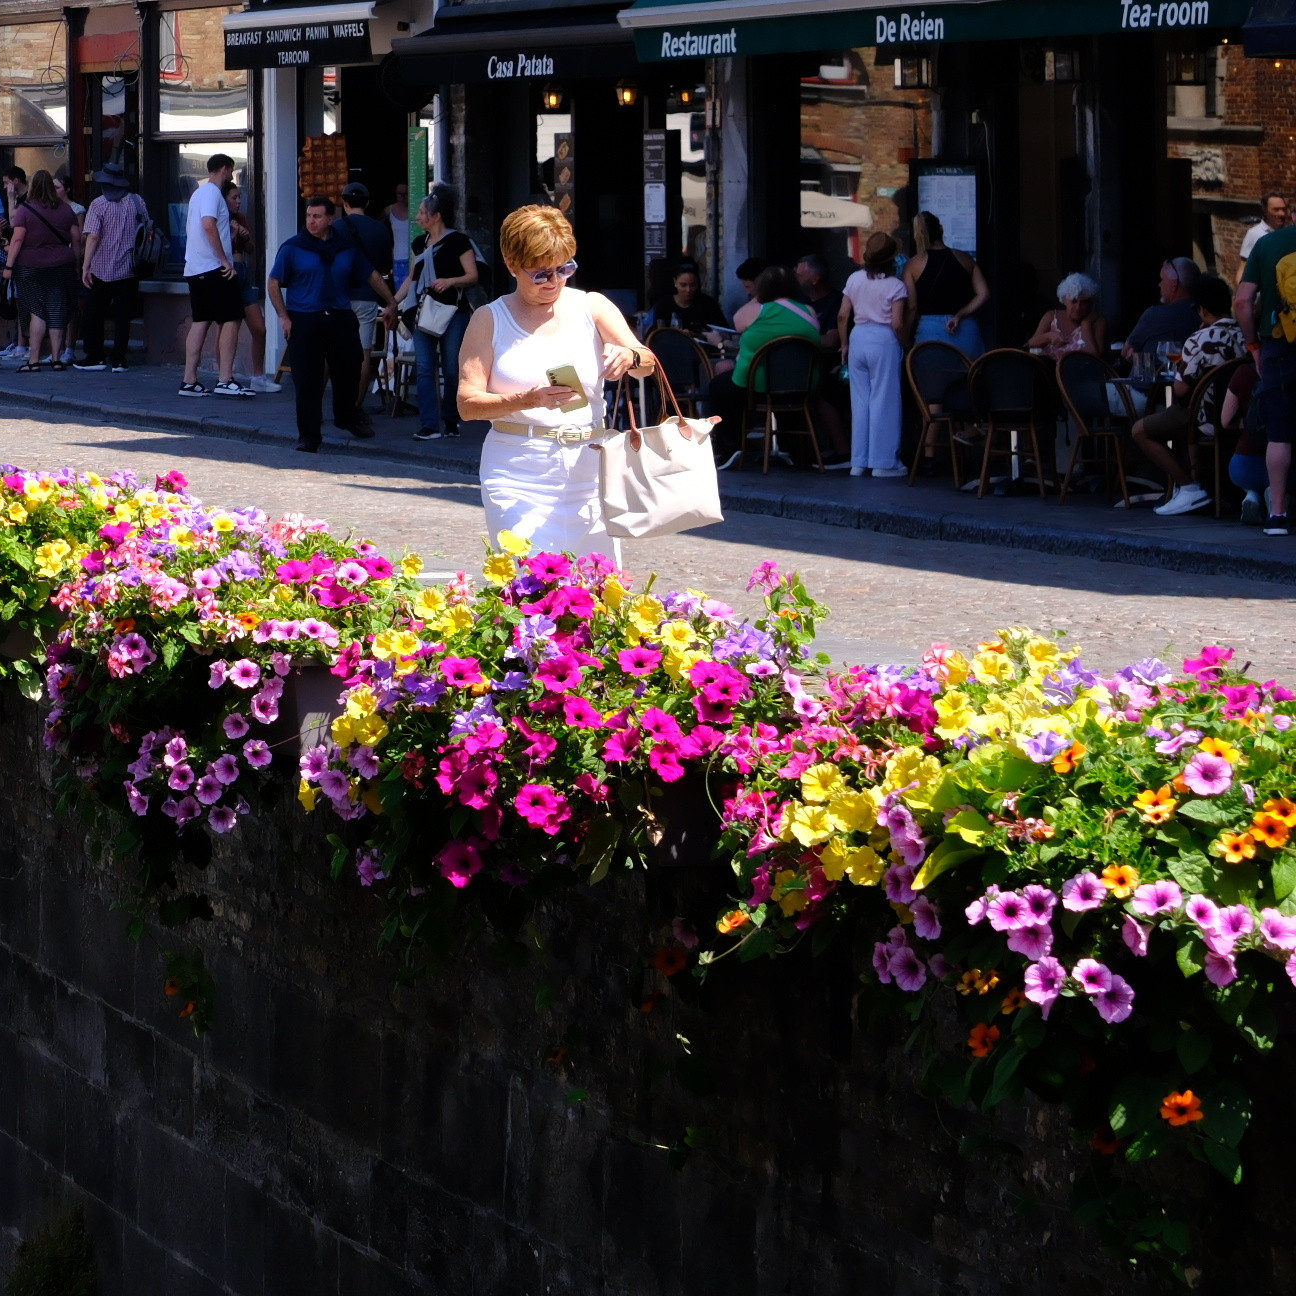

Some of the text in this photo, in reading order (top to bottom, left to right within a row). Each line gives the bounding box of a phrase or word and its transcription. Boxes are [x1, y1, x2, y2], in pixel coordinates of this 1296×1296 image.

[226, 23, 365, 46] BREAKFAST SANDWICH PANINI WAFFELS
[875, 11, 944, 44] De Reien
[660, 27, 737, 58] Restaurant
[277, 50, 310, 65] TEAROOM
[487, 53, 554, 79] Casa Patata
